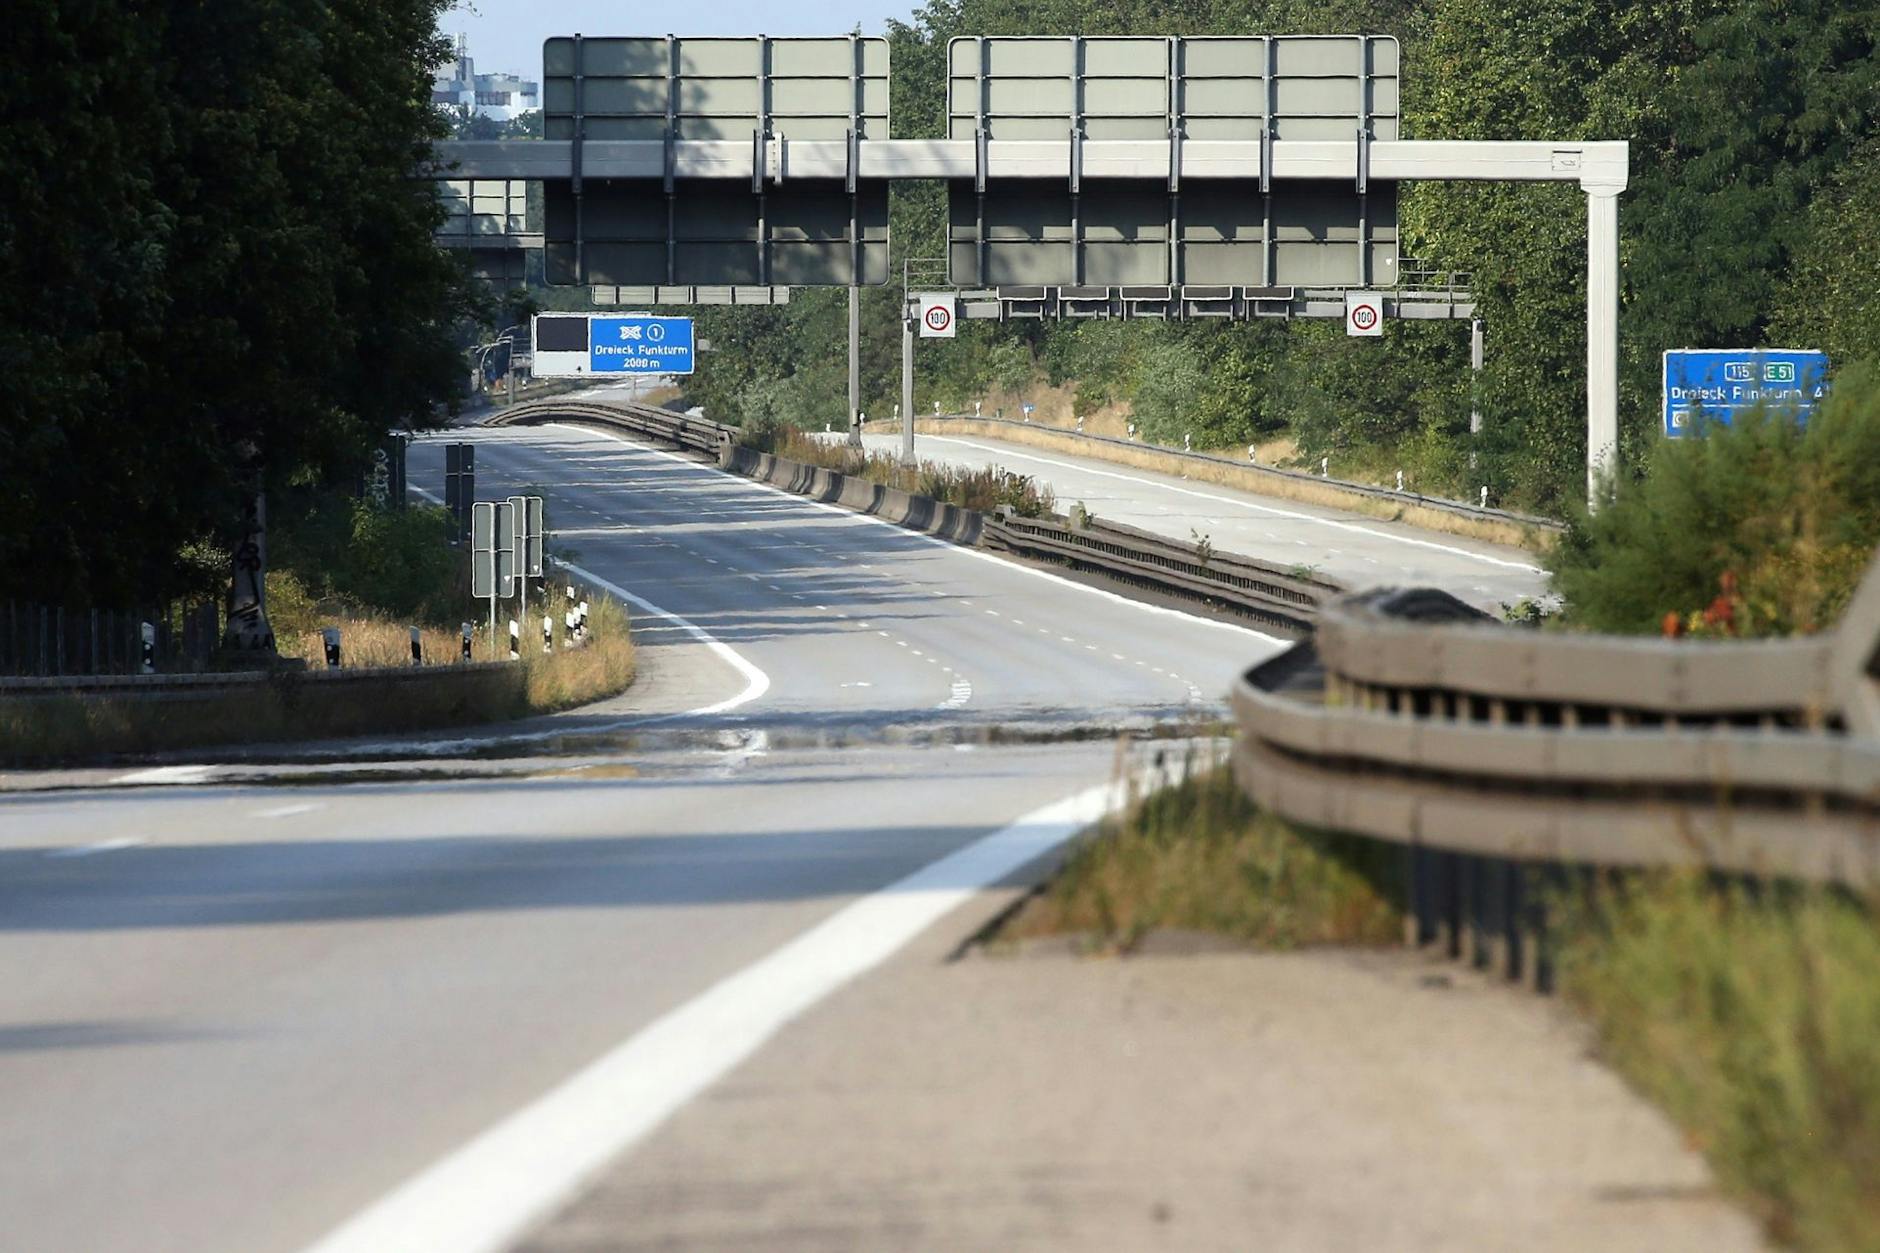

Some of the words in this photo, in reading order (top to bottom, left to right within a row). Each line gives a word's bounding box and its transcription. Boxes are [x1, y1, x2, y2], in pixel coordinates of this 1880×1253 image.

[1357, 311, 1372, 323] 100
[594, 345, 635, 355] Dreieck
[638, 345, 688, 355] Funkturm
[623, 358, 648, 368] 2000
[649, 359, 660, 368] m
[1732, 365, 1750, 378] 115
[1766, 365, 1776, 378] E
[1778, 365, 1792, 378] 51
[1732, 386, 1803, 400] Funkurm
